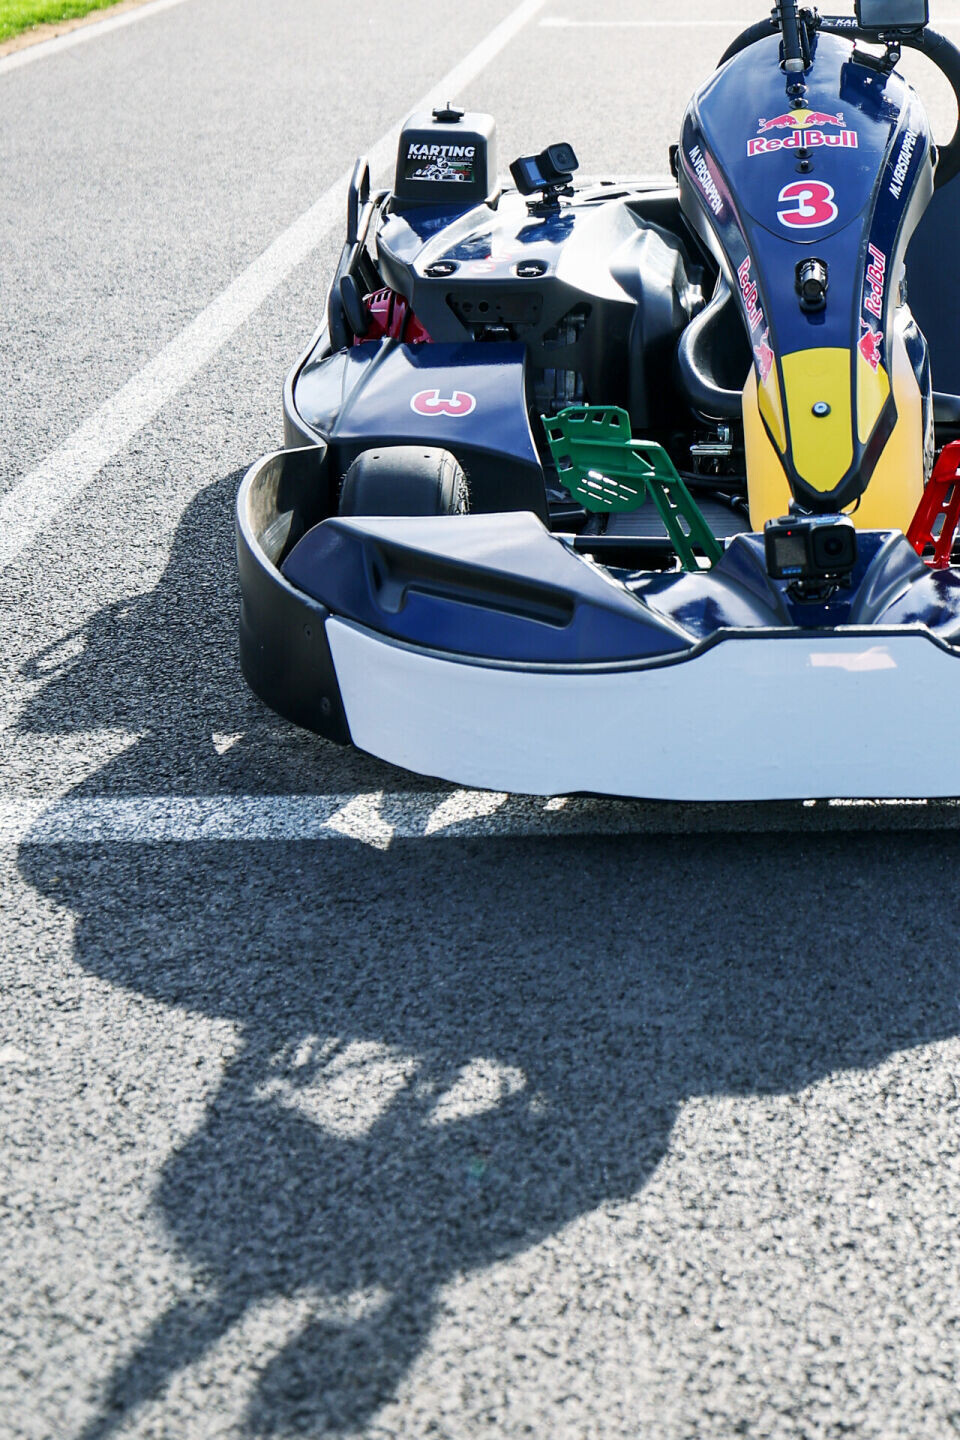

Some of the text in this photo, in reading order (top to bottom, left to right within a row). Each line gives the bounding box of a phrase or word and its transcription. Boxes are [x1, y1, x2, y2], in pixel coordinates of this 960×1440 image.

[408, 143, 476, 158] KARTING
[747, 129, 859, 157] Red Bull
[777, 180, 839, 229] 3
[737, 255, 765, 334] Red Bull
[864, 243, 886, 320] Red Bull
